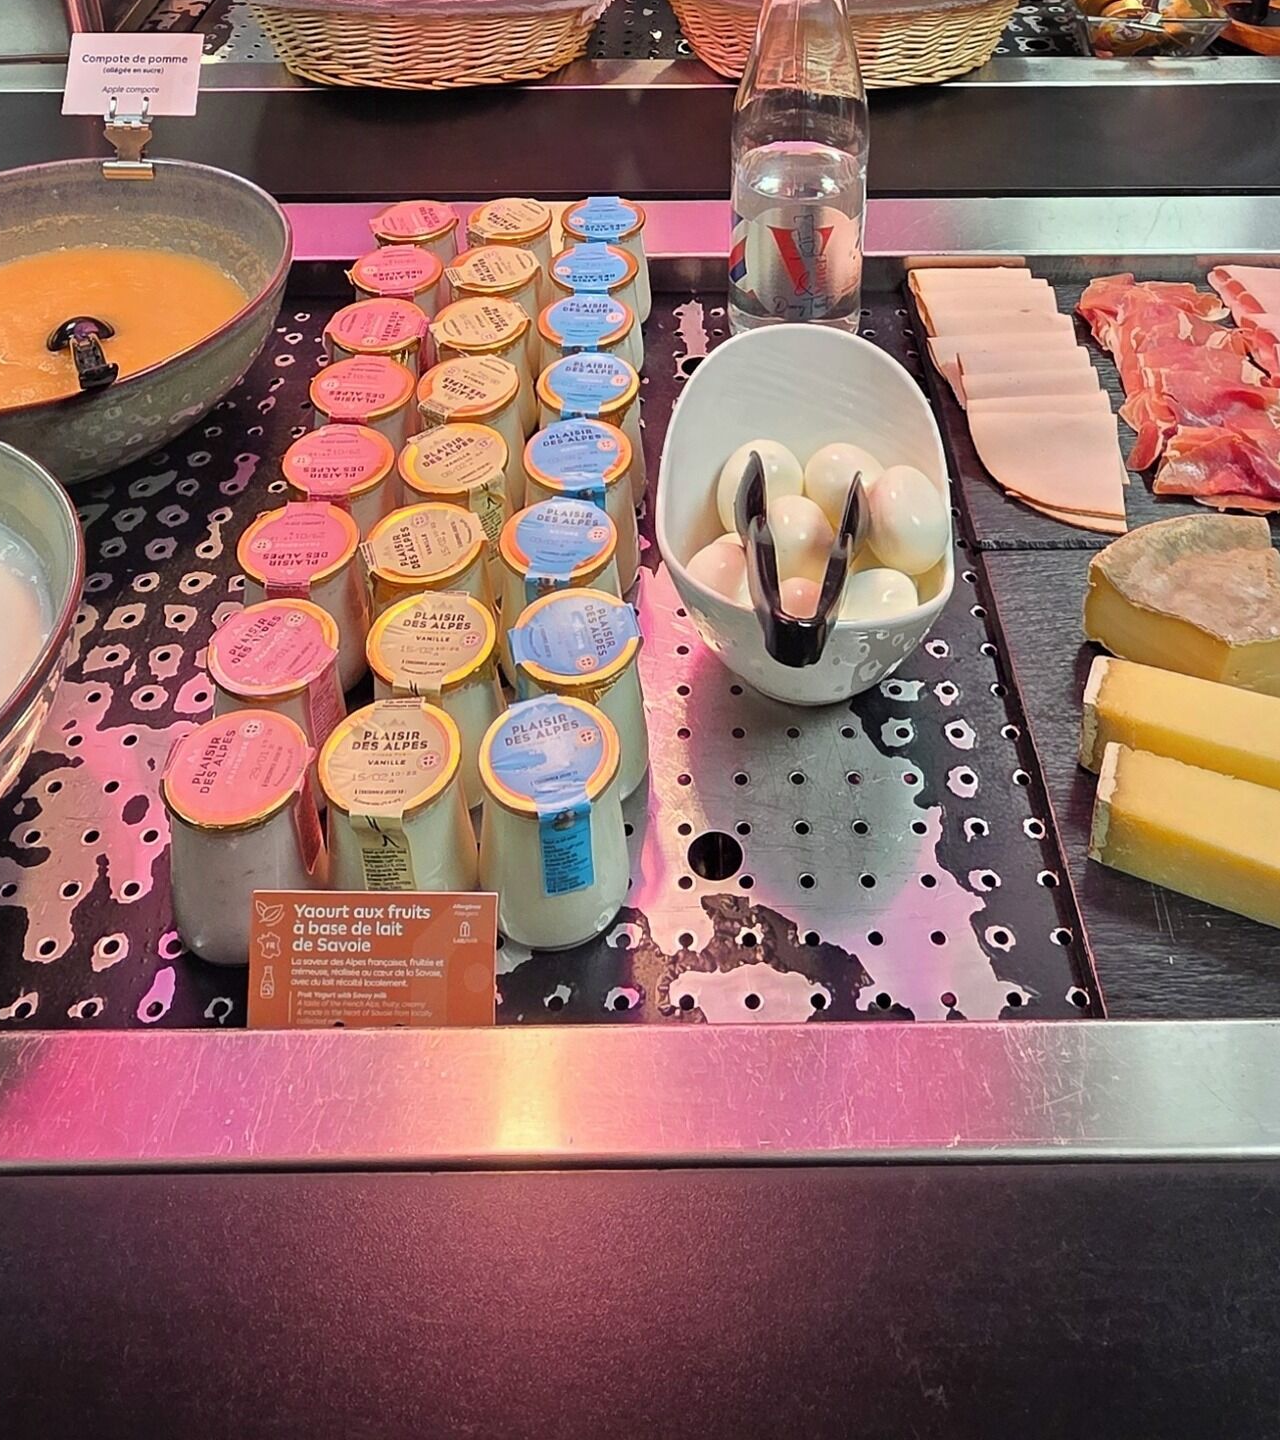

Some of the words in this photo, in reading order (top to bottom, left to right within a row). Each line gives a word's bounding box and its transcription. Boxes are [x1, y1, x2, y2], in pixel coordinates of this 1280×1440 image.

[82, 54, 130, 64] Compote
[132, 55, 146, 63] de
[148, 56, 188, 64] pomme
[101, 86, 124, 94] Apple
[542, 439, 564, 447] DES
[567, 434, 602, 444] ALPES
[548, 428, 593, 440] PLAISIR
[536, 513, 559, 524] DES
[561, 517, 600, 527] ALPES
[546, 508, 593, 519] PLAISIR
[400, 526, 416, 553] ALPES
[392, 534, 409, 567] PLAISIR
[408, 554, 421, 570] DES
[414, 611, 466, 622] PLAISIR
[584, 604, 598, 624] DES
[402, 619, 427, 628] DES
[430, 622, 472, 630] ALPES
[597, 608, 616, 649] PLAISIR
[229, 617, 268, 656] PLAISIR
[590, 627, 608, 657] ALPES
[231, 646, 253, 665] DES
[511, 713, 568, 735] PLAISIR
[363, 731, 421, 741] PLAISIR
[504, 733, 531, 747] DES
[535, 720, 580, 739] ALPES
[352, 741, 379, 750] DES
[383, 740, 429, 751] ALPES
[192, 737, 222, 785] PLAISIR
[200, 771, 217, 794] DES
[214, 730, 237, 767] ALPES
[294, 904, 350, 918] Yaourt
[353, 907, 384, 919] aux
[388, 904, 431, 919] fruits
[293, 920, 304, 935] à
[308, 921, 347, 935] base
[351, 921, 372, 935] de
[376, 921, 403, 936] lait
[292, 937, 313, 952] de
[317, 938, 371, 952] Savoie
[291, 957, 302, 966] La
[330, 958, 344, 966] des
[345, 958, 366, 967] Alpes
[435, 959, 444, 967] et
